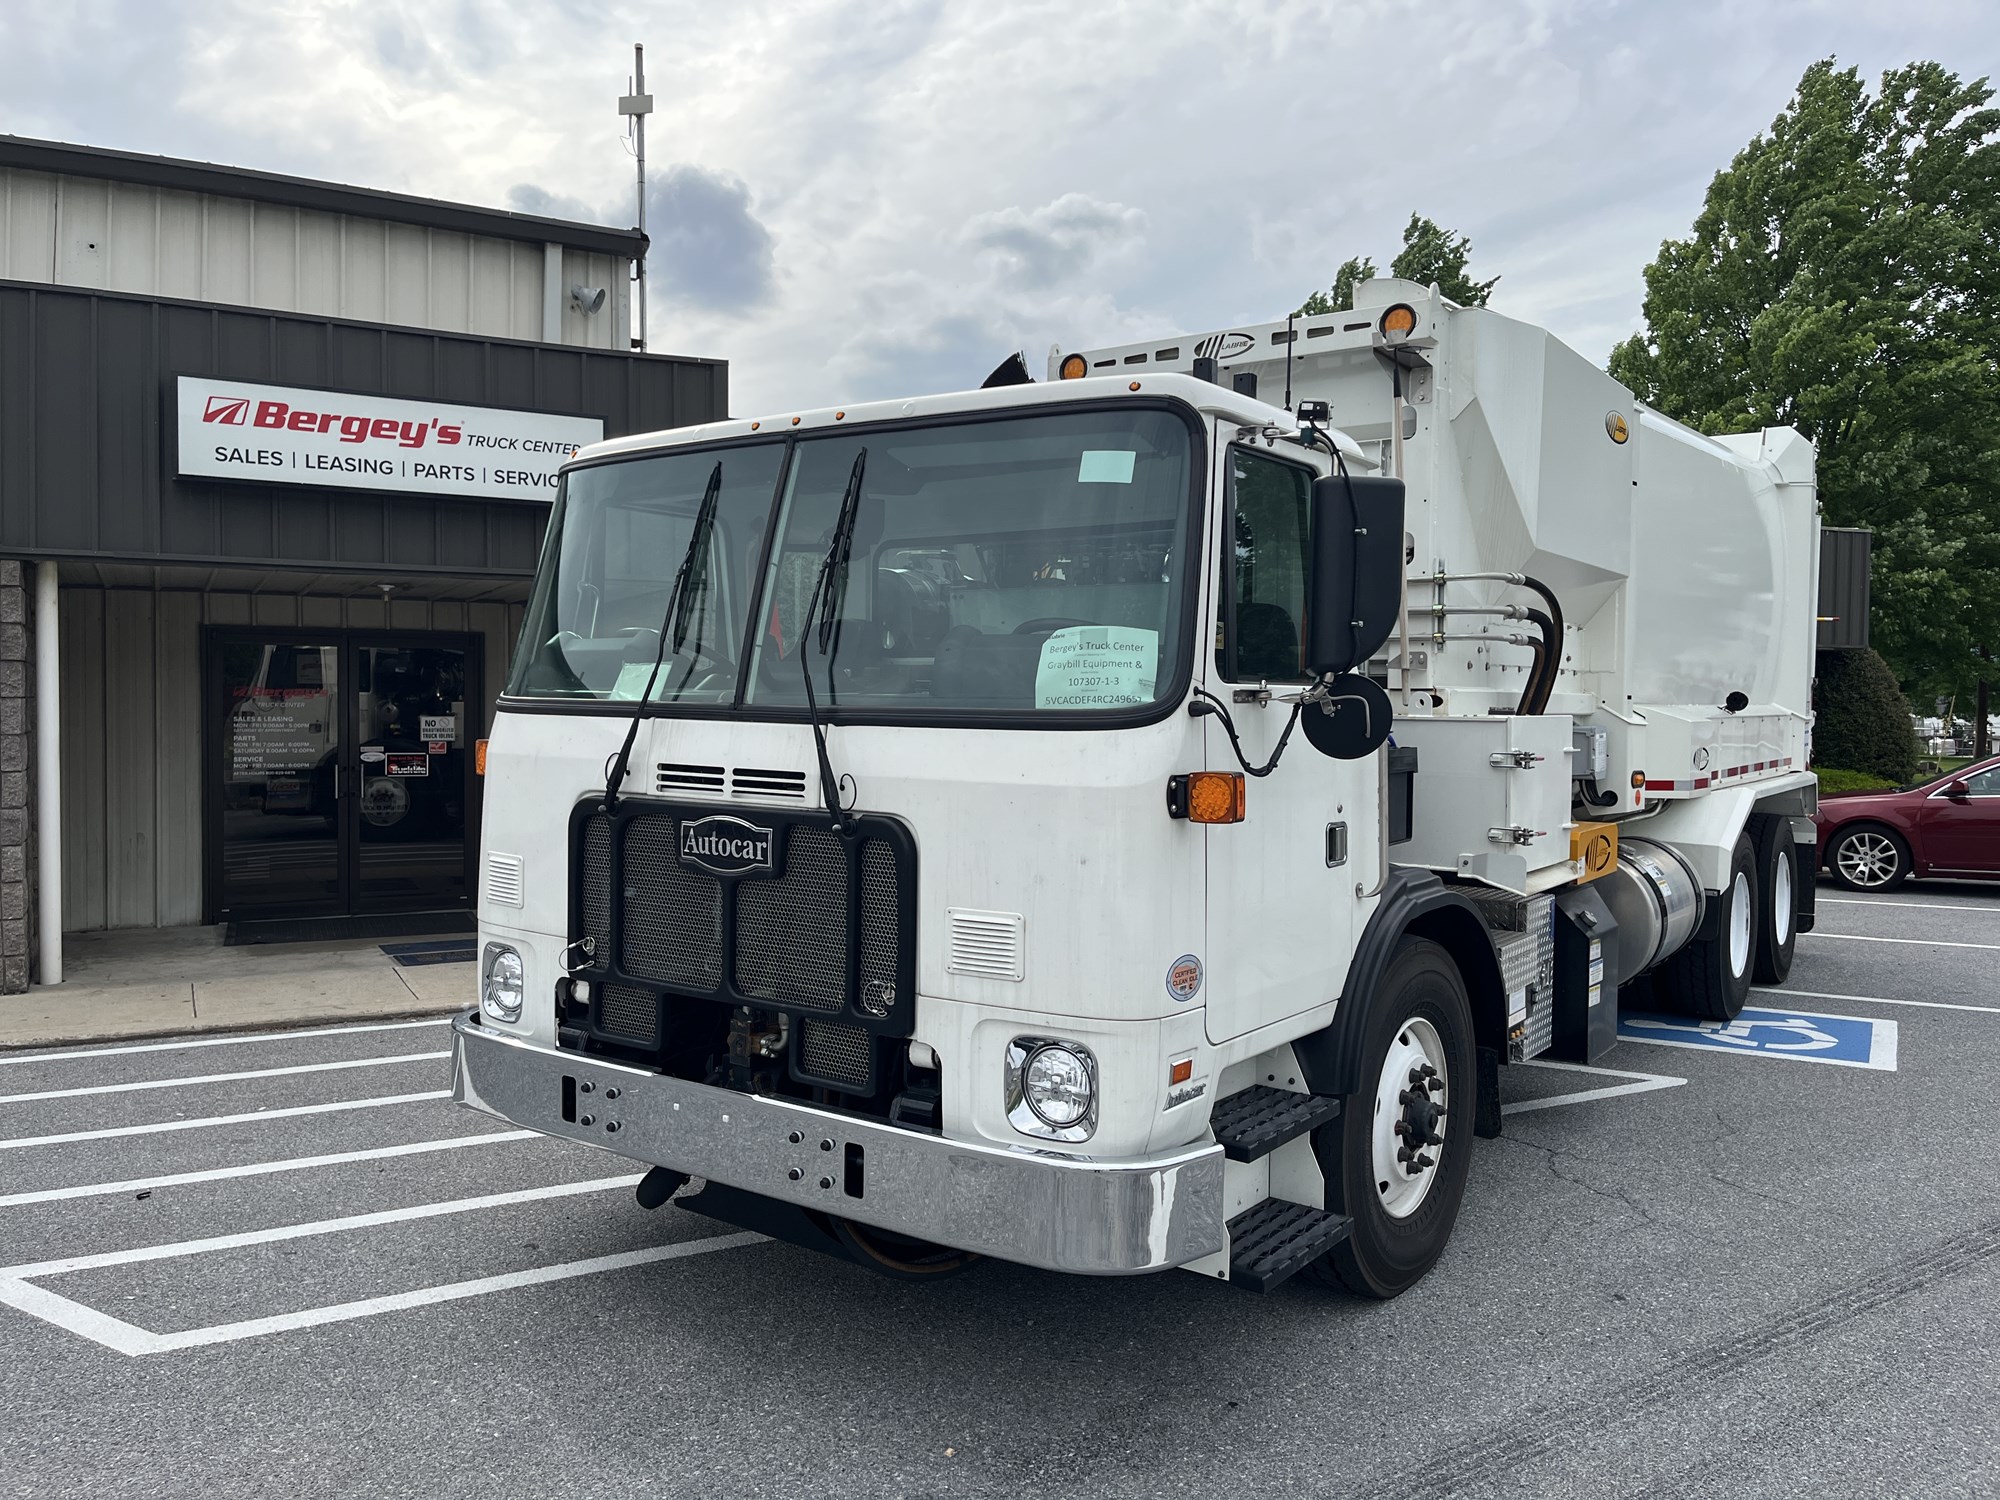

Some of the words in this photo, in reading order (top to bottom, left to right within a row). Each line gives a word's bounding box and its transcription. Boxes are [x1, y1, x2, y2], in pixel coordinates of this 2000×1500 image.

[253, 400, 462, 449] Bergey's
[467, 434, 518, 451] TRUCK
[214, 446, 284, 467] SALES
[305, 454, 394, 476] LEASING
[414, 463, 476, 482] PARTS
[494, 469, 559, 488] SERVIC
[1050, 642, 1083, 654] Bergey's
[1086, 641, 1111, 651] Truck
[1113, 642, 1144, 652] Center
[1047, 660, 1081, 670] Graybill
[1083, 659, 1132, 670] Equipment
[1135, 660, 1143, 669] &
[1068, 677, 1120, 687] 107307-1-3
[684, 828, 767, 860] Autocar
[1172, 978, 1188, 987] CLEAN
